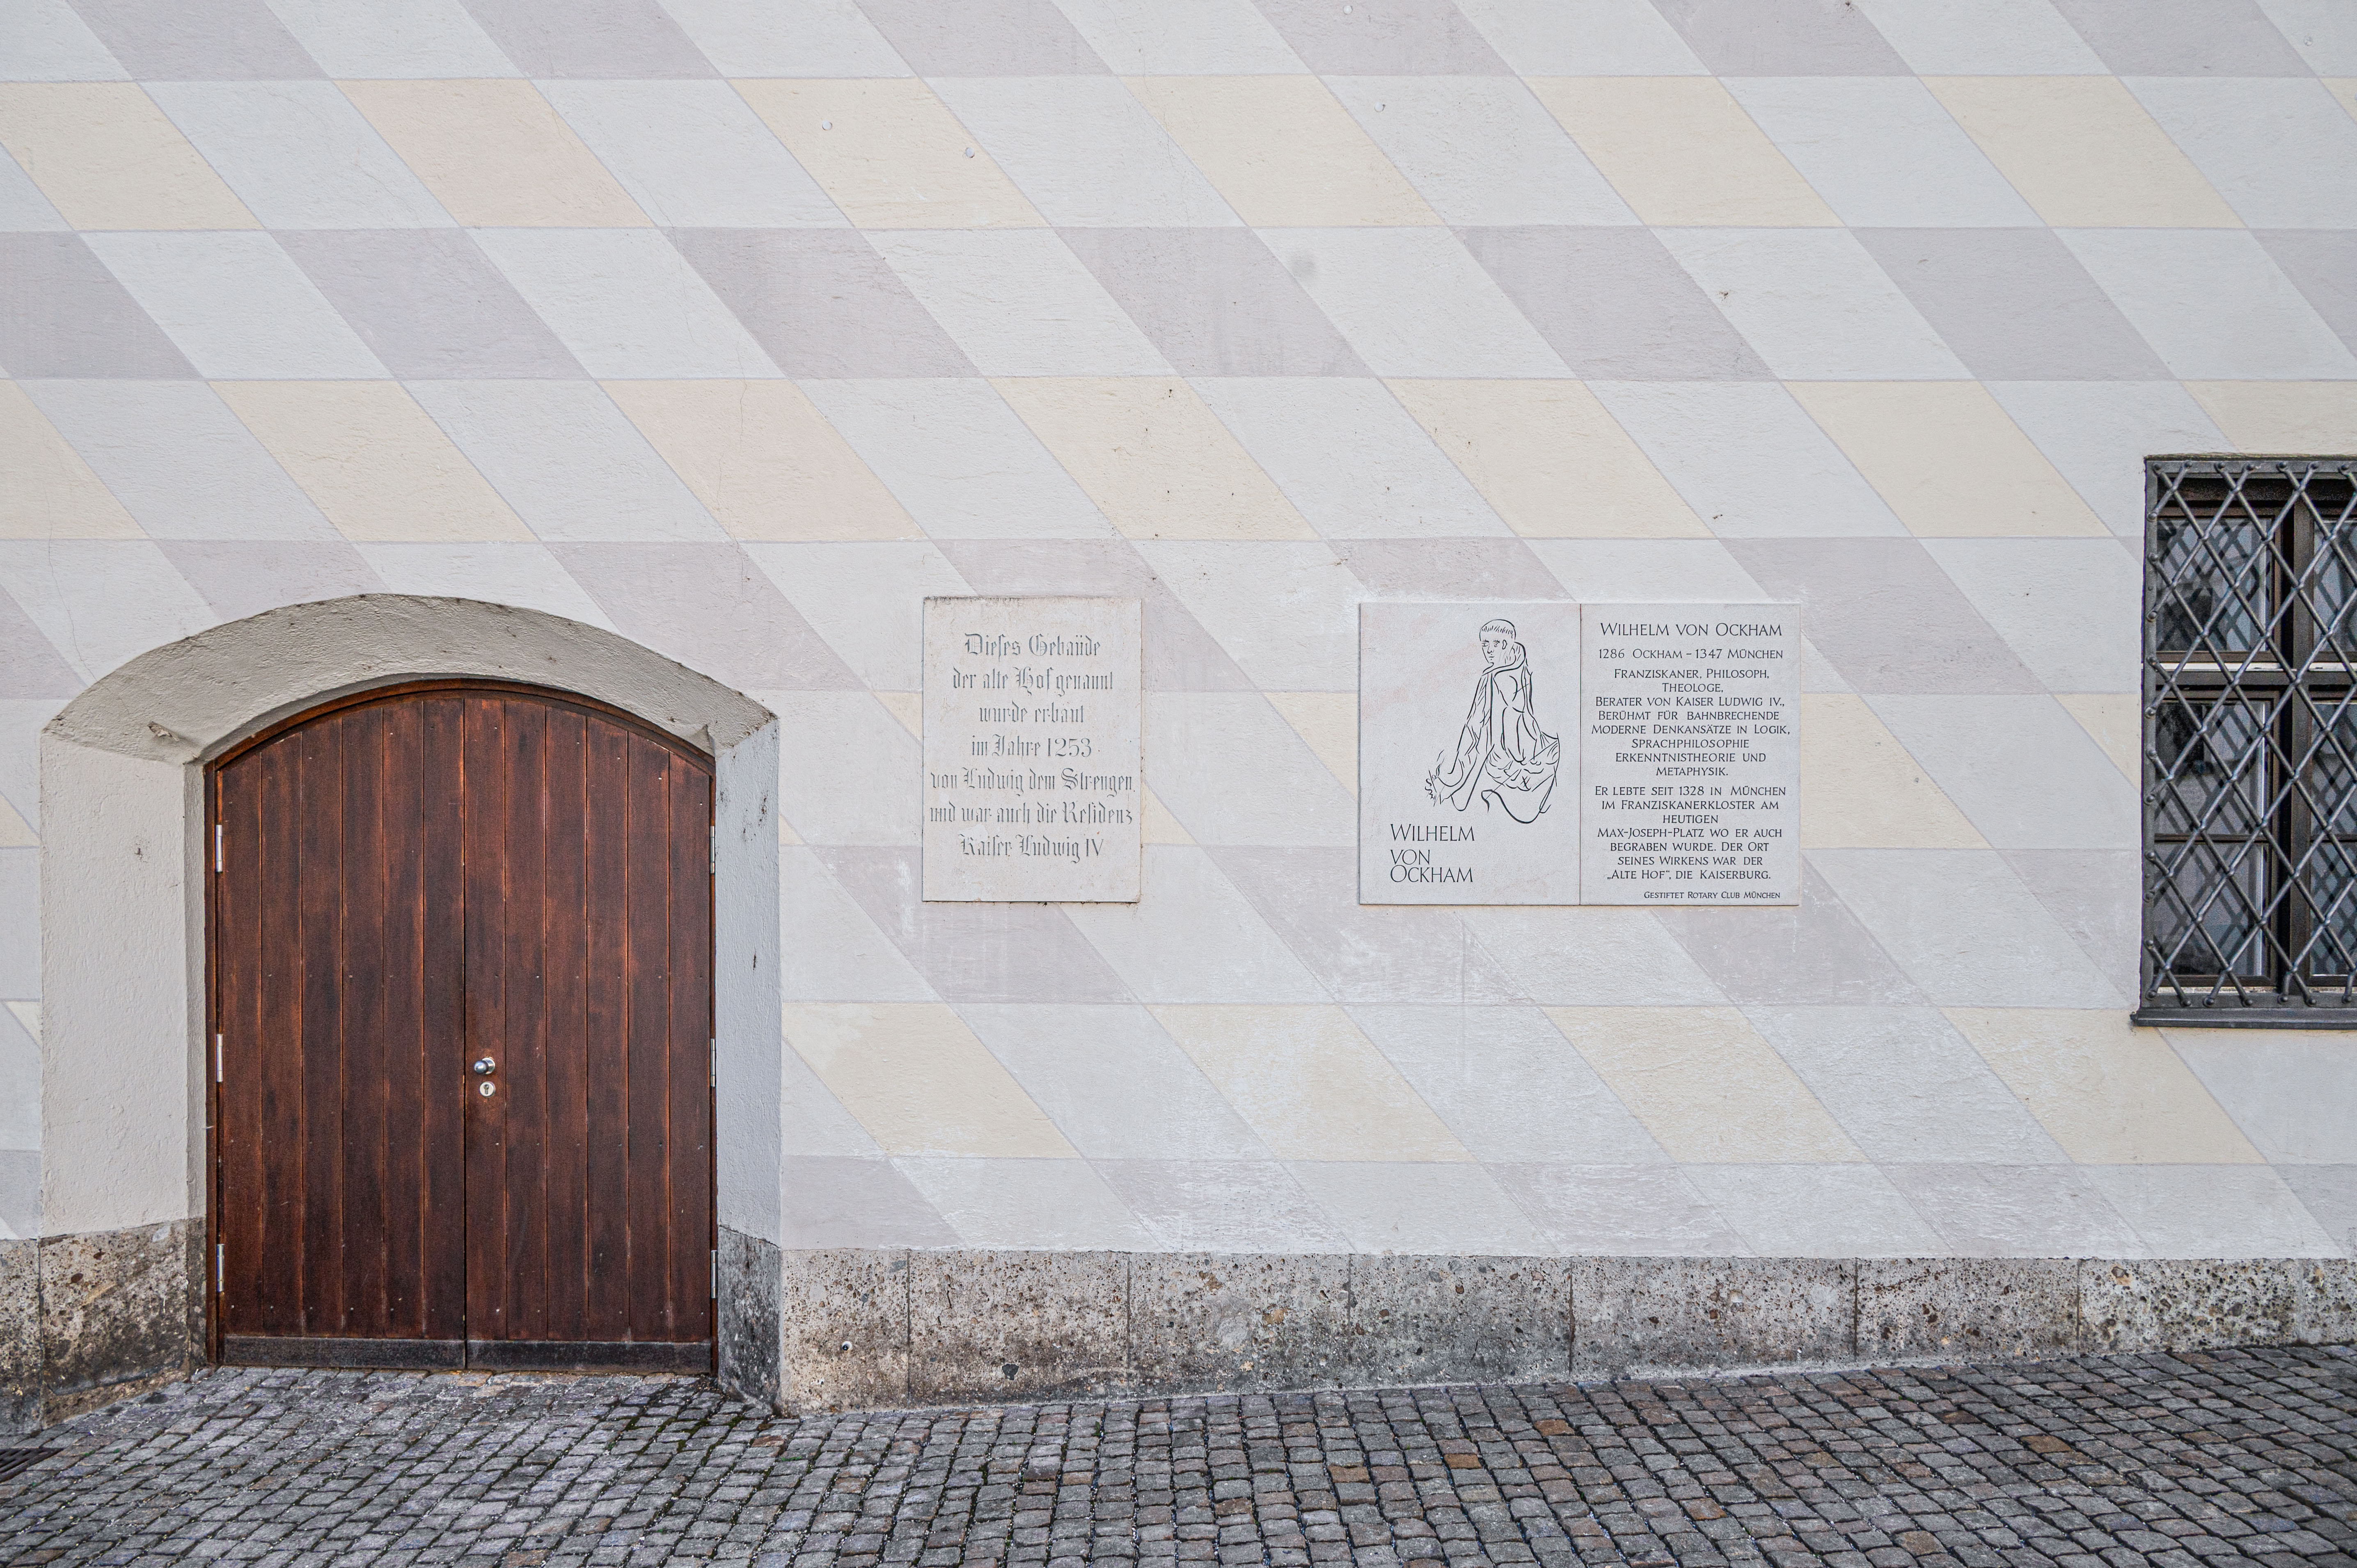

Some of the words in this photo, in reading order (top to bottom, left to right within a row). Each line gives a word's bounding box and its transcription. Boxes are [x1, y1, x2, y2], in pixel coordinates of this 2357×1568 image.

[1600, 623, 1670, 636] WILHELM
[1675, 623, 1709, 636] VON
[1716, 623, 1782, 637] OCKHAM
[1599, 648, 1625, 659] 1286
[1632, 648, 1683, 659] OCKHAM
[1695, 649, 1723, 659] 1347
[1727, 649, 1783, 659] MÜNCHEN
[1614, 668, 1702, 680] FRANZISKANER,
[1706, 668, 1769, 680] PHILOSOPH,
[953, 666, 977, 689] der
[983, 668, 1009, 689] alte
[1012, 666, 1054, 696] Hof
[1056, 671, 1113, 697] genannt
[1662, 682, 1724, 694] THEOLOGE,
[1595, 697, 1642, 706] BERATER
[1647, 698, 1671, 707] VON
[1676, 697, 1713, 706] KAISER
[1719, 697, 1763, 707] LUDWIG
[979, 700, 1028, 722] wurde
[1034, 702, 1085, 723] erbaut
[1598, 710, 1651, 720] BERÜHMT
[1658, 710, 1678, 720] FÜR
[1687, 711, 1779, 720] BAHNBRECHENDE
[1591, 724, 1646, 735] MODERNE
[1653, 724, 1731, 735] DENKANSÄTZE
[1737, 725, 1747, 734] IN
[1754, 724, 1790, 735] LOGIK,
[971, 735, 988, 756] im
[992, 734, 1041, 757] Jahre
[1047, 738, 1092, 758] 1253
[1631, 739, 1749, 748] SPRACHPHILOSOPHIE
[1615, 753, 1736, 762] ERKENNTNISTHEORIE
[1743, 753, 1766, 762] UND
[1656, 767, 1729, 776] METAPHYSIK.
[930, 772, 957, 790] von
[962, 767, 1024, 797] Ludwig
[1029, 767, 1056, 790] dem
[1595, 786, 1608, 796] ER
[1613, 786, 1645, 796] LEBTE
[1651, 786, 1674, 796] SEIT
[1679, 786, 1704, 796] 1328
[1710, 787, 1722, 796] IN
[1730, 785, 1786, 796] MÜNCHEN
[1601, 801, 1615, 810] IM
[1621, 800, 1755, 810] FRANZISKANERKLOSTER
[1761, 801, 1779, 810] AM
[929, 801, 956, 822] und
[961, 808, 992, 822] war
[996, 802, 1030, 824] auch
[1037, 801, 1057, 823] die
[1663, 815, 1718, 824] HEUTIGEN
[1390, 823, 1475, 842] WILHELM
[1597, 827, 1704, 839] MAX-JOSEPH-PLATZ
[1710, 829, 1729, 838] WO
[1735, 829, 1749, 838] ER
[1754, 829, 1782, 838] AUCH
[1015, 835, 1080, 864] Ludwig
[1086, 838, 1104, 857] IV
[1610, 842, 1667, 852] BEGRABEN
[1672, 842, 1716, 852] WURDE.
[1721, 842, 1743, 852] DER
[1748, 842, 1769, 852] ORT
[1390, 849, 1430, 865] VON
[1617, 856, 1655, 866] SEINES
[1659, 856, 1709, 866] WIRKENS
[1713, 856, 1736, 865] WAR
[1743, 856, 1763, 865] DER
[1390, 865, 1473, 883] OCKHAM
[1675, 870, 1693, 879] DIE
[1700, 870, 1771, 880] KAISERBURG.
[1688, 891, 1718, 899] ROTARY
[1721, 891, 1740, 899] CLUB
[1743, 891, 1780, 899] MÜNCHEN
